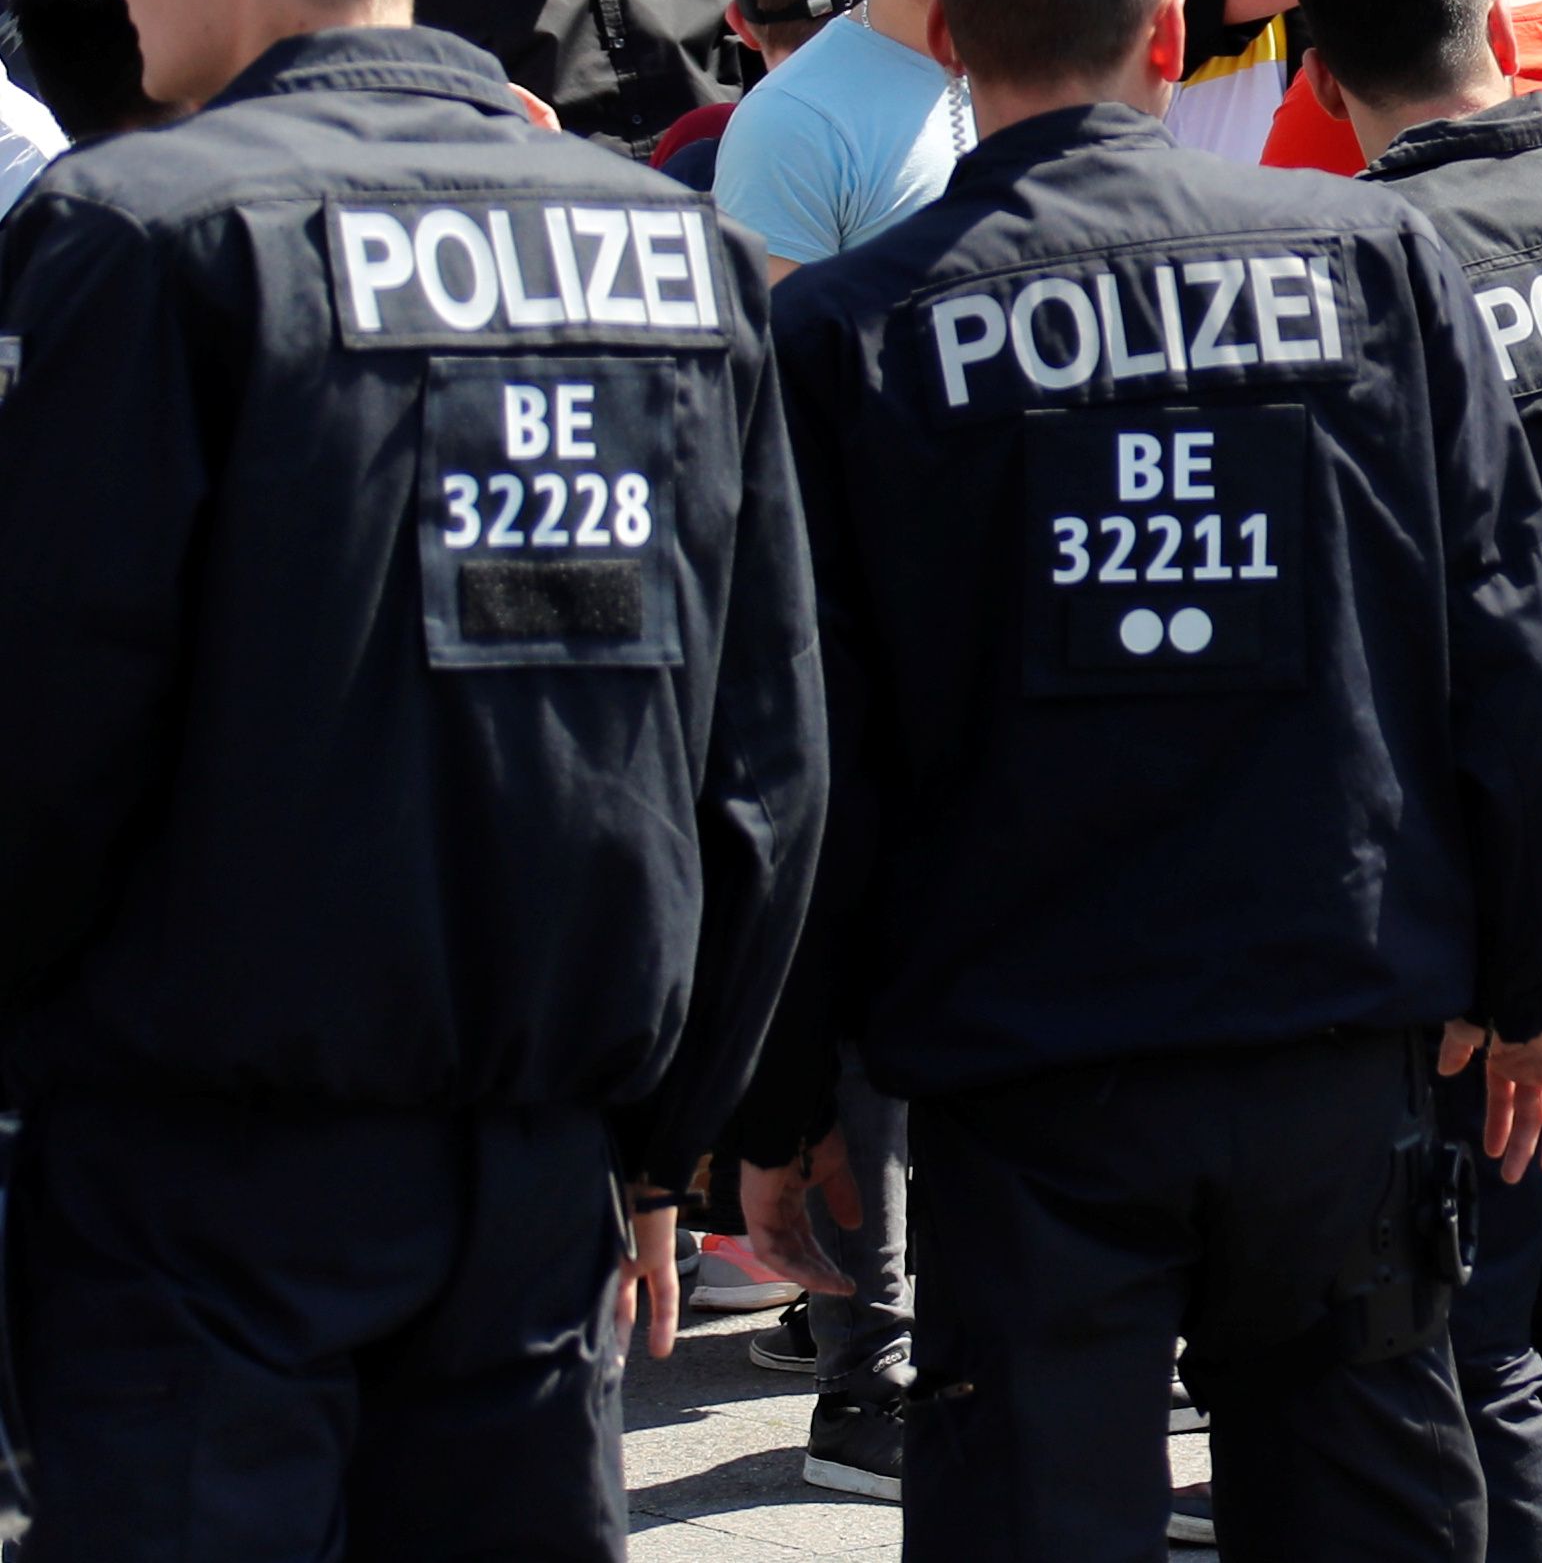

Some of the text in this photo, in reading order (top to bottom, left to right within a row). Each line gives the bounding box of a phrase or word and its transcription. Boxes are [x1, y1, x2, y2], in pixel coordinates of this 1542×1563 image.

[339, 206, 720, 332] POLIZEI
[931, 255, 1344, 408] POLIZEI
[504, 384, 597, 461] BE
[1118, 432, 1216, 502] BE
[443, 473, 652, 549] 32228
[1052, 512, 1278, 585] 32211
